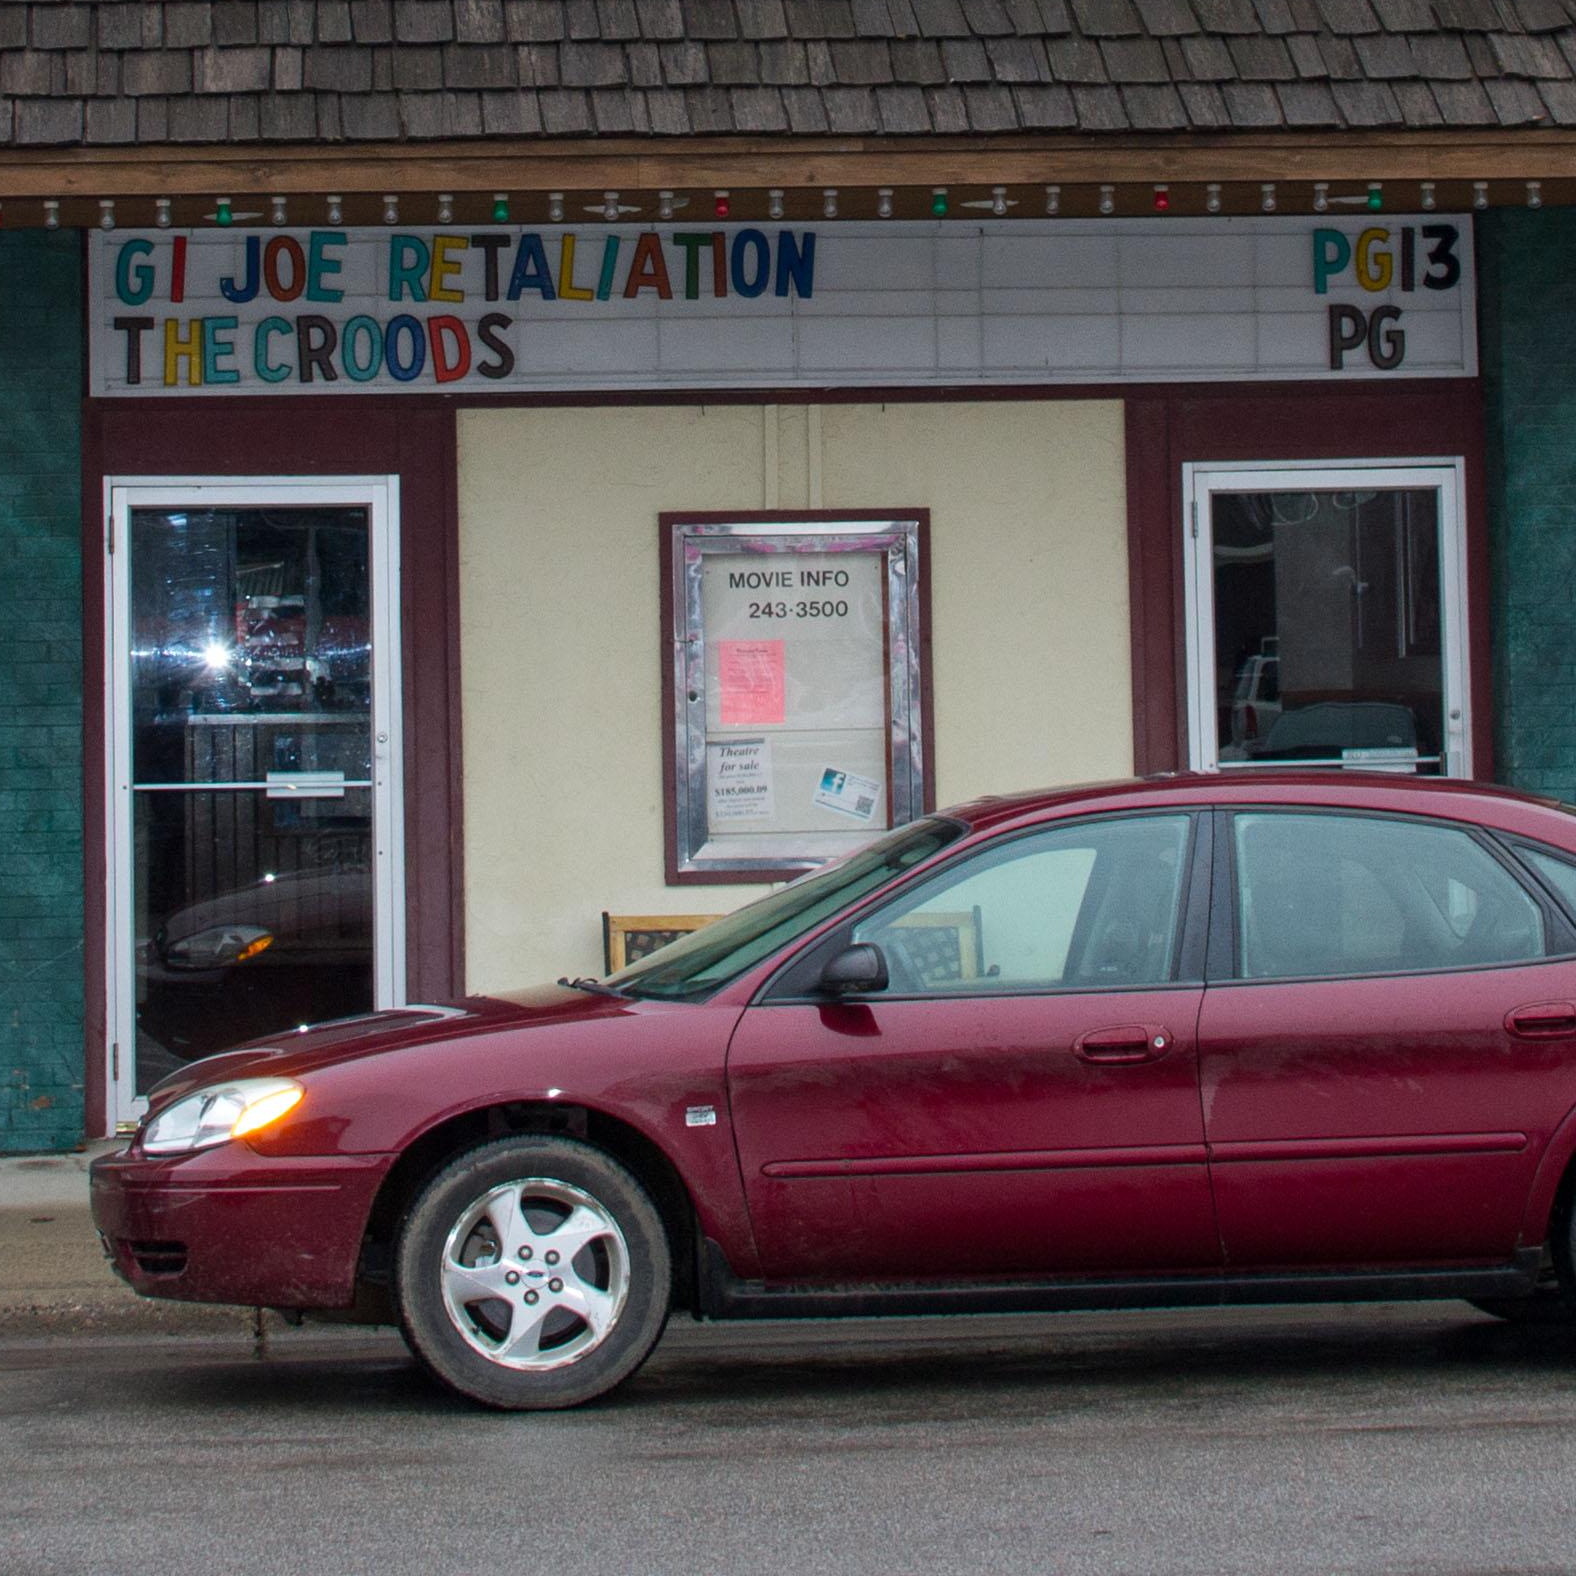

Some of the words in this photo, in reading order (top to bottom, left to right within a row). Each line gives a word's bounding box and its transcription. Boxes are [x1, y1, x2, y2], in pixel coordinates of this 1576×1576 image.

[115, 235, 187, 306] GI
[219, 231, 348, 304] JOE
[388, 228, 816, 304] RETALIATION
[1313, 224, 1461, 295] PG13
[114, 316, 240, 387] THE
[253, 312, 515, 384] CROODS
[1328, 304, 1406, 371] PG
[729, 571, 794, 590] MOVIE
[800, 569, 850, 588] INFO
[720, 747, 760, 758] Theatre
[720, 761, 736, 774] for
[739, 759, 760, 771] sale
